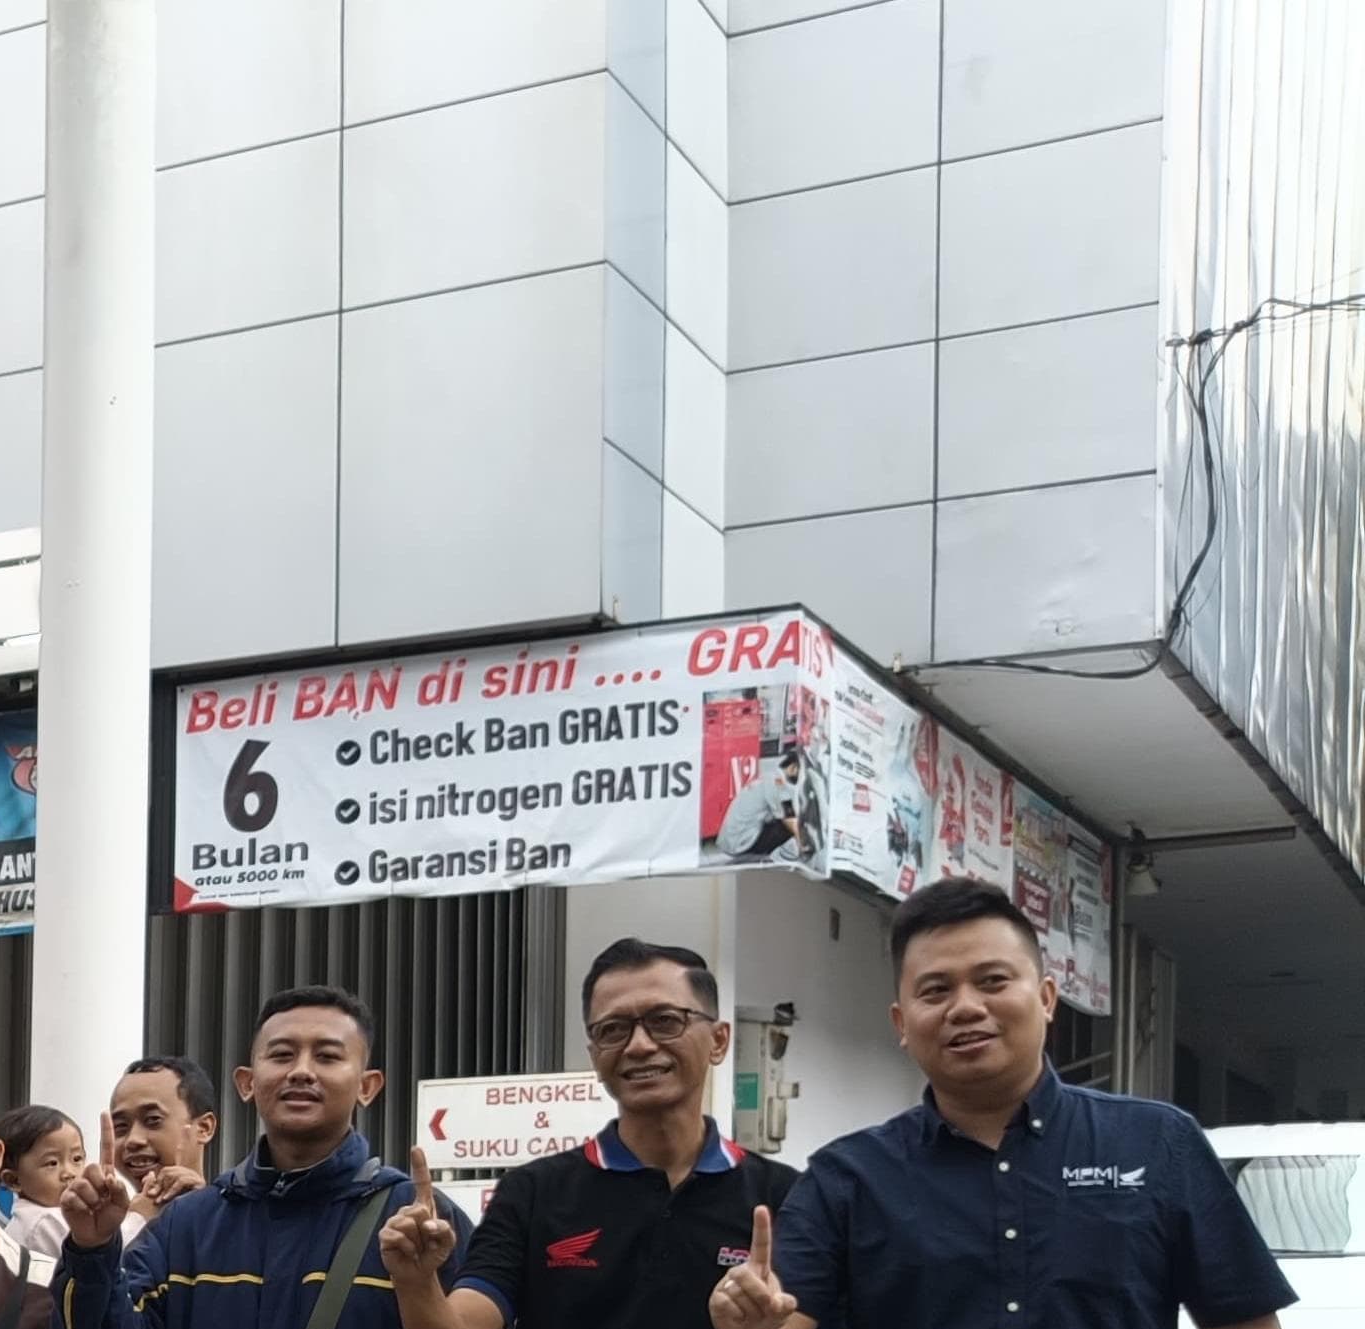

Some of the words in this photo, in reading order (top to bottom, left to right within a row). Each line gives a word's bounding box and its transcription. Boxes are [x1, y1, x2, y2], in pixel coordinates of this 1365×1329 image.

[184, 680, 276, 734] Beli
[292, 666, 401, 721] BAN
[418, 660, 465, 702] di
[482, 647, 579, 699] sini
[369, 721, 475, 766] Check
[484, 717, 549, 753] Ban
[558, 699, 680, 744] GRATIS
[224, 739, 279, 832] 6
[369, 789, 409, 825] isi
[416, 776, 562, 824] nitrogen
[571, 760, 692, 805] GRATIS
[0, 854, 35, 881] AN
[192, 838, 309, 870] Bulan
[369, 839, 497, 884] Garansi
[505, 837, 571, 872] Ban
[195, 874, 232, 886] atau
[237, 869, 278, 883] 5000
[282, 868, 305, 880] km
[486, 1083, 601, 1106] BENGKEL
[534, 1111, 550, 1129] &
[453, 1138, 519, 1159] SUKU
[1062, 1166, 1113, 1180] MPM
